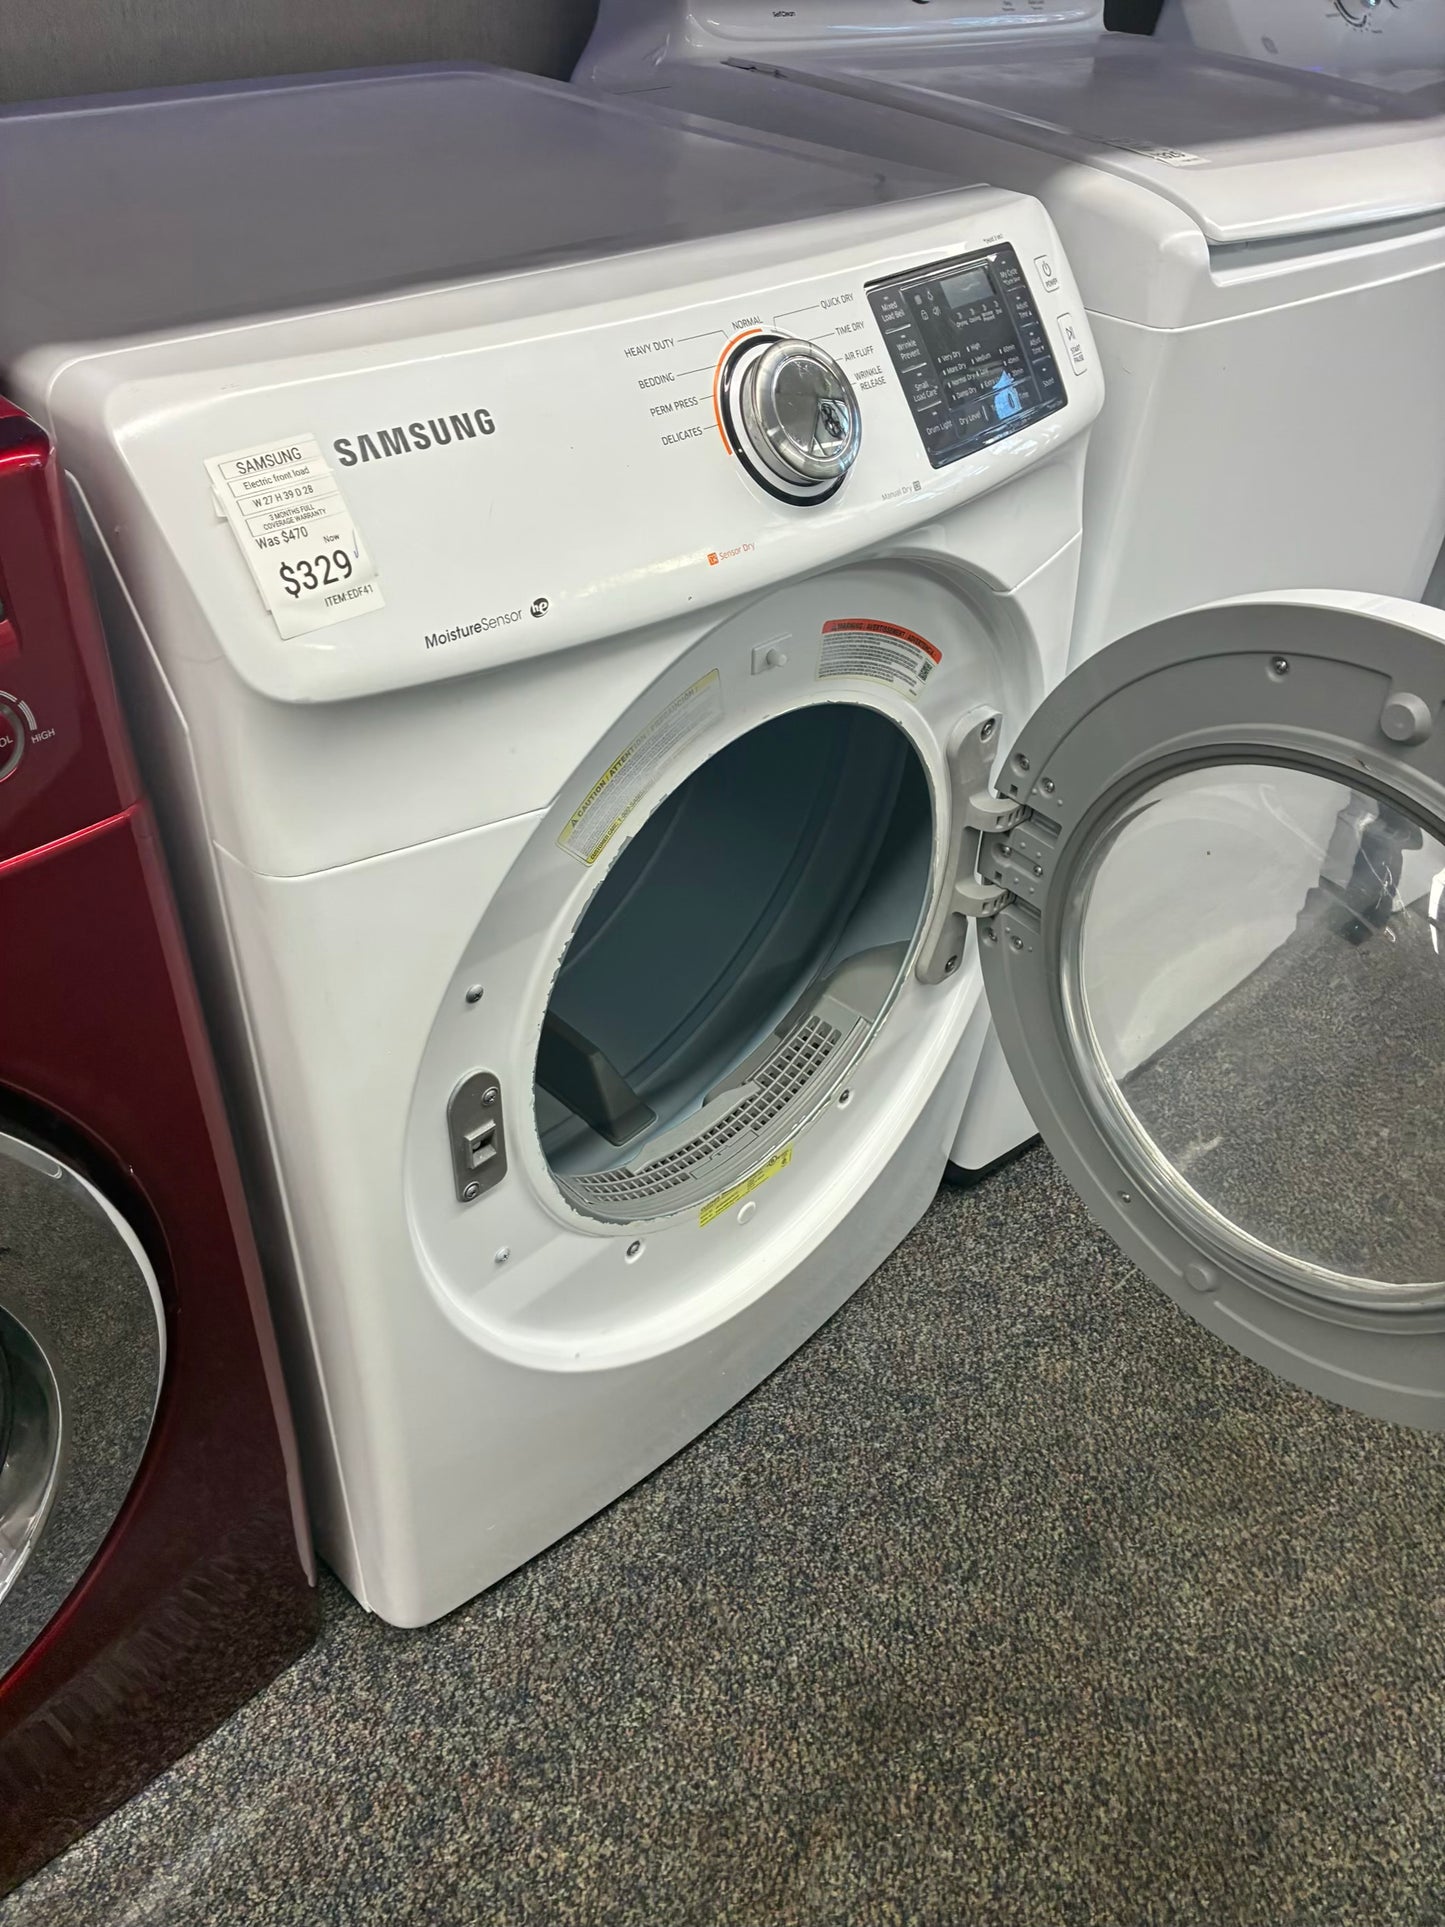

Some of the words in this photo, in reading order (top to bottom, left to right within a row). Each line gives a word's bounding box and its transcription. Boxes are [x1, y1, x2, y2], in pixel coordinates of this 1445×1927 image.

[820, 296, 840, 310] QUICK
[841, 292, 854, 304] DRY
[881, 300, 898, 312] Mixed
[732, 316, 763, 331] NORMAL
[881, 312, 896, 322] Load
[835, 325, 850, 337] TIME
[850, 321, 865, 333] DRY
[624, 344, 652, 359] HEAVY
[654, 338, 675, 352] DUTY
[845, 351, 856, 362] AIR
[856, 345, 875, 359] FLUFF
[896, 340, 917, 351] Wrinkle
[900, 348, 920, 360] Prevent
[941, 354, 953, 363] Very
[952, 350, 961, 359] Dry
[854, 365, 883, 382] WRINKLE
[946, 366, 958, 374] More
[957, 363, 967, 371] Dry
[638, 372, 676, 389] BEDDING
[860, 376, 887, 391] RELEASE
[914, 381, 929, 392] Small
[913, 392, 926, 402] Load
[650, 404, 673, 418] PERM
[674, 396, 699, 412] PRESS
[959, 415, 970, 426] Dry
[969, 411, 982, 422] Level
[661, 426, 703, 446] DELICATES
[926, 424, 940, 435] Drum
[941, 420, 953, 432] Light
[334, 408, 496, 468] SAMSUNG
[236, 447, 302, 475] SAMSUNG
[243, 476, 273, 490] Electric
[274, 471, 292, 482] front
[294, 466, 310, 478] load
[253, 497, 264, 508] W
[264, 494, 274, 505] 27
[276, 493, 283, 502] H
[284, 489, 294, 500] 39
[296, 488, 302, 496] D
[303, 484, 314, 494] 28
[881, 487, 902, 502] Manual
[902, 485, 913, 495] Dry
[263, 517, 294, 530] COVERAGE
[294, 508, 327, 523] WARRANTY
[275, 508, 299, 520] MONTHS
[300, 504, 314, 514] FULL
[255, 534, 280, 550] Was
[281, 526, 308, 544] $470
[323, 533, 340, 544] Now
[719, 546, 742, 561] Sensor
[743, 542, 756, 553] Dry
[279, 549, 353, 598] $329
[324, 584, 374, 608] ITEM:EDF41
[424, 608, 522, 649] MoistureSensor
[31, 728, 56, 744] HIGH
[578, 780, 606, 817] CAUTION
[610, 734, 647, 777] ATTENTION
